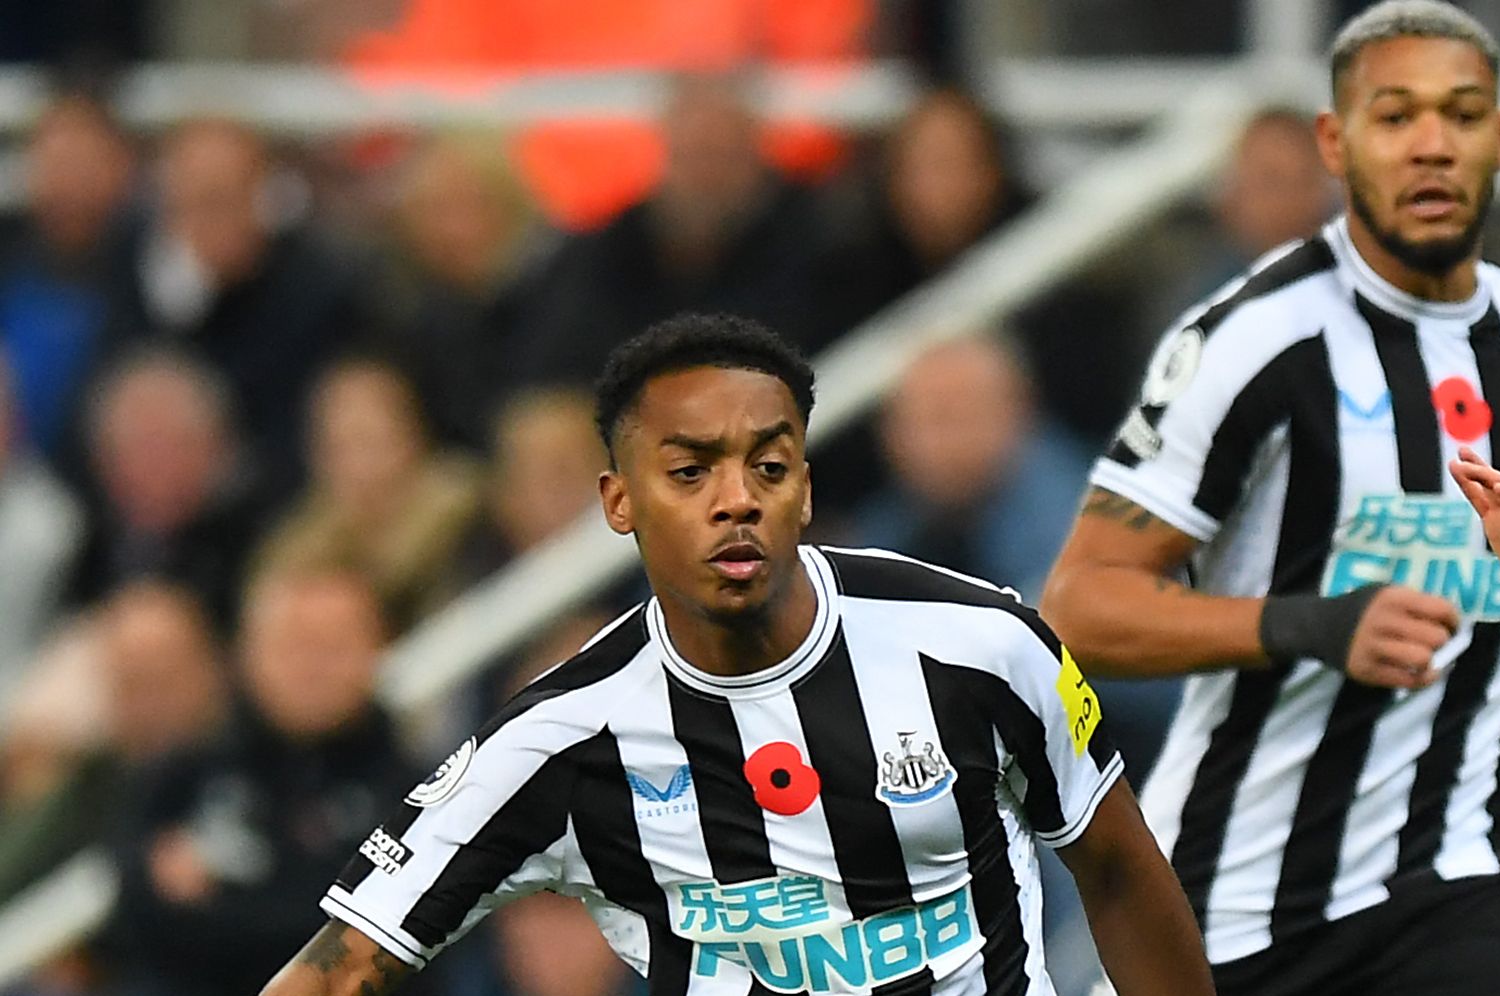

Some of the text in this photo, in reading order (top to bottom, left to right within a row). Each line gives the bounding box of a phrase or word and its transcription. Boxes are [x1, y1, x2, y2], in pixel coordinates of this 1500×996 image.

[678, 875, 830, 933] 乐天堂
[696, 887, 972, 993] FUN88
